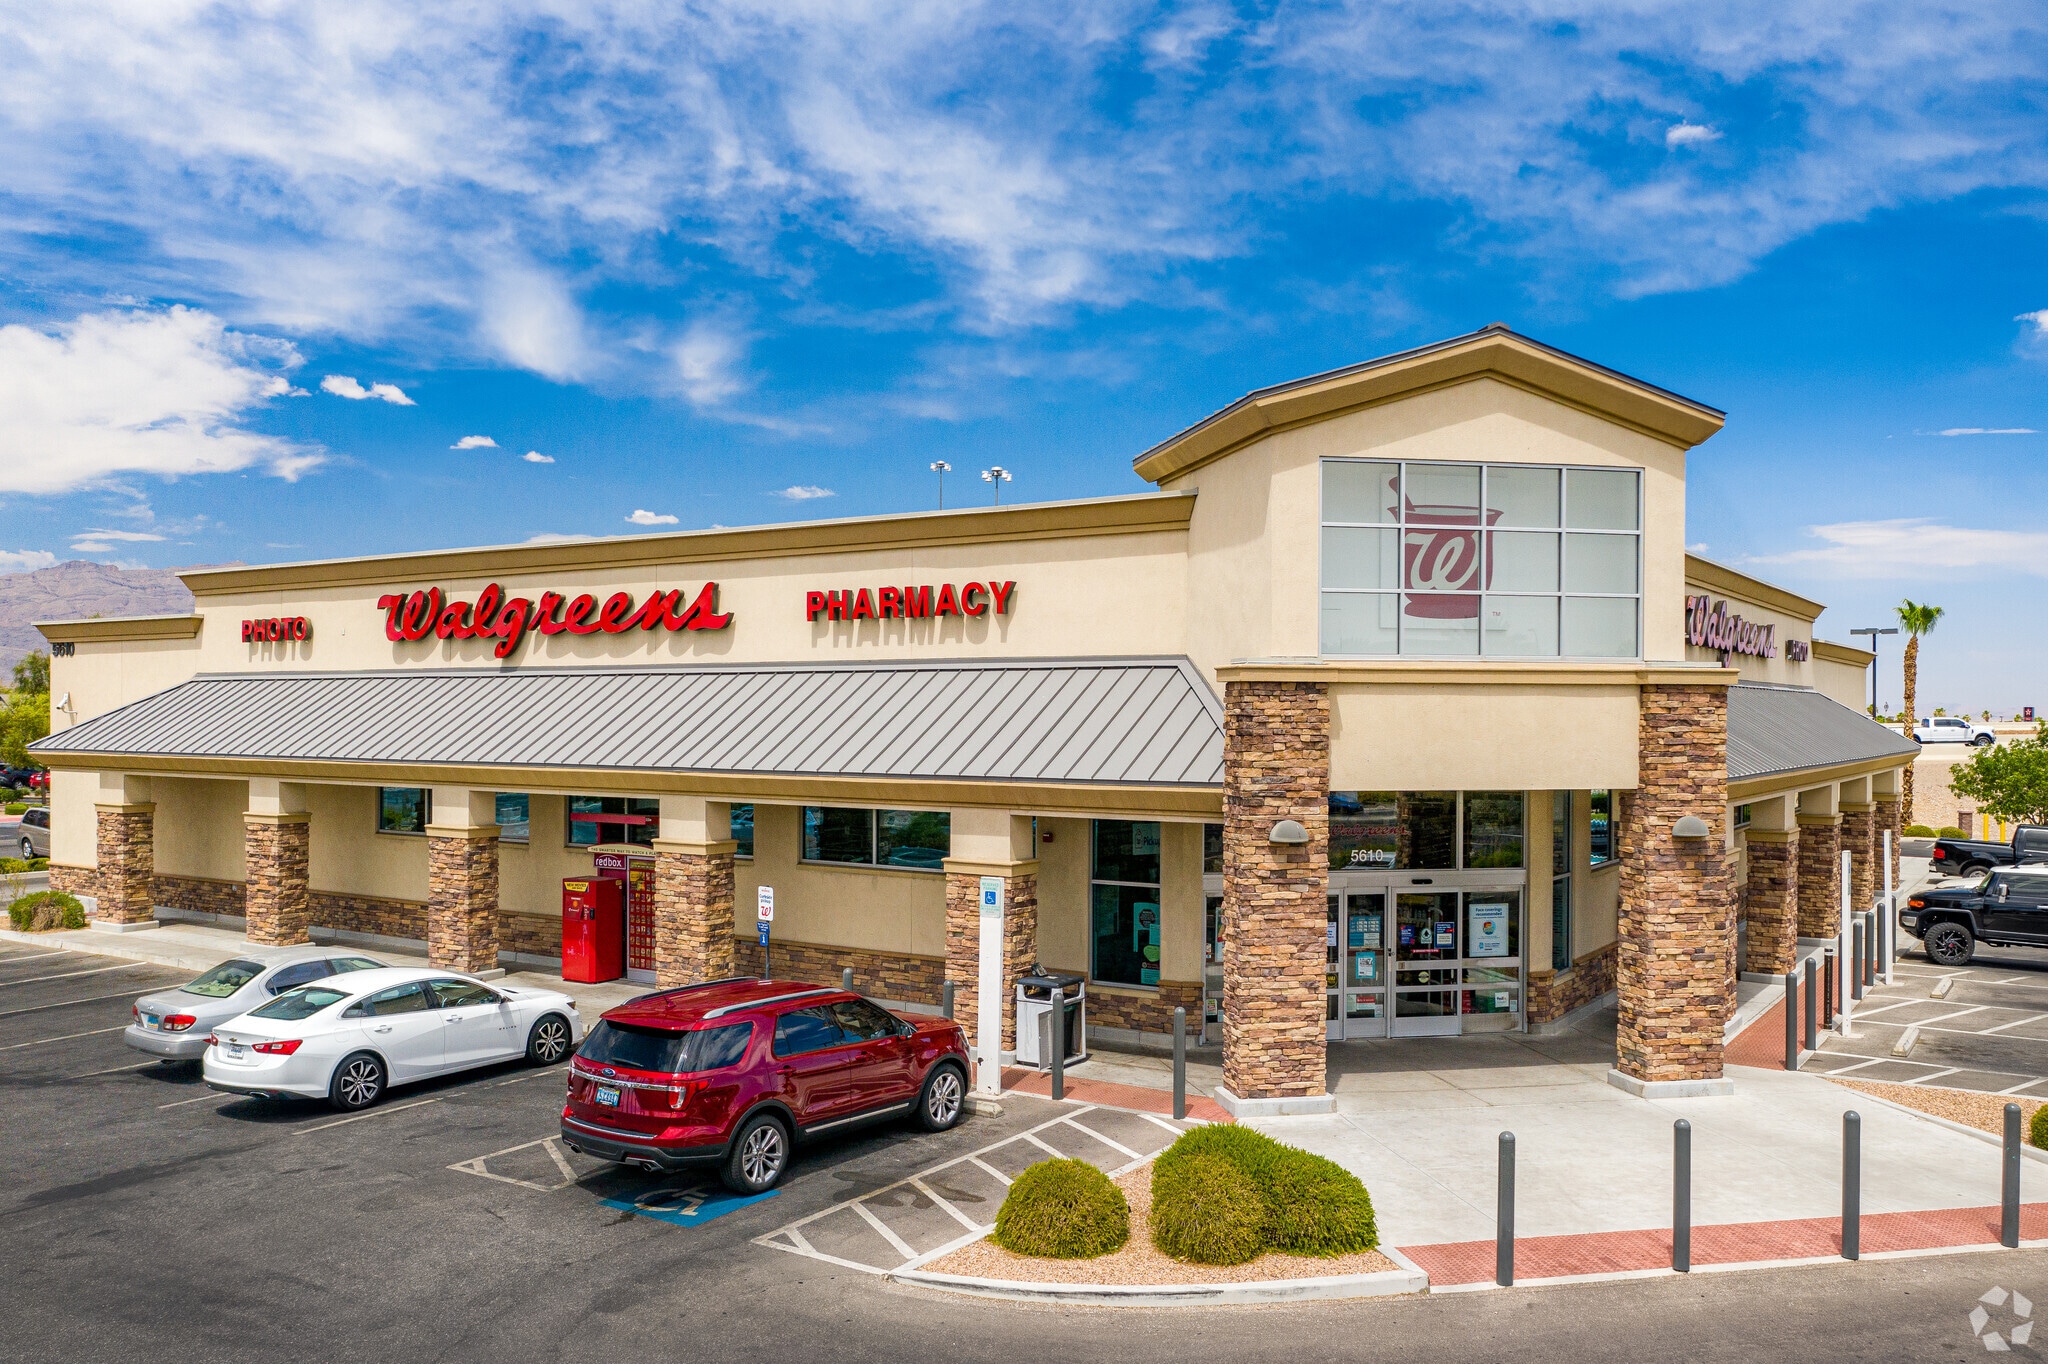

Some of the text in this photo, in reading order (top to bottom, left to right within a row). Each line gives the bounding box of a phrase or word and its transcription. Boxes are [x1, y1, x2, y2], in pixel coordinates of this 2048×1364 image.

[806, 581, 1017, 622] PHARMACY
[241, 616, 311, 643] PHOTO
[377, 581, 735, 658] Walgreens
[1685, 594, 1778, 668] Walgreens
[52, 642, 76, 657] 5610
[1331, 824, 1411, 839] Walgreens
[595, 857, 622, 867] redbox
[1350, 849, 1384, 862] 5610
